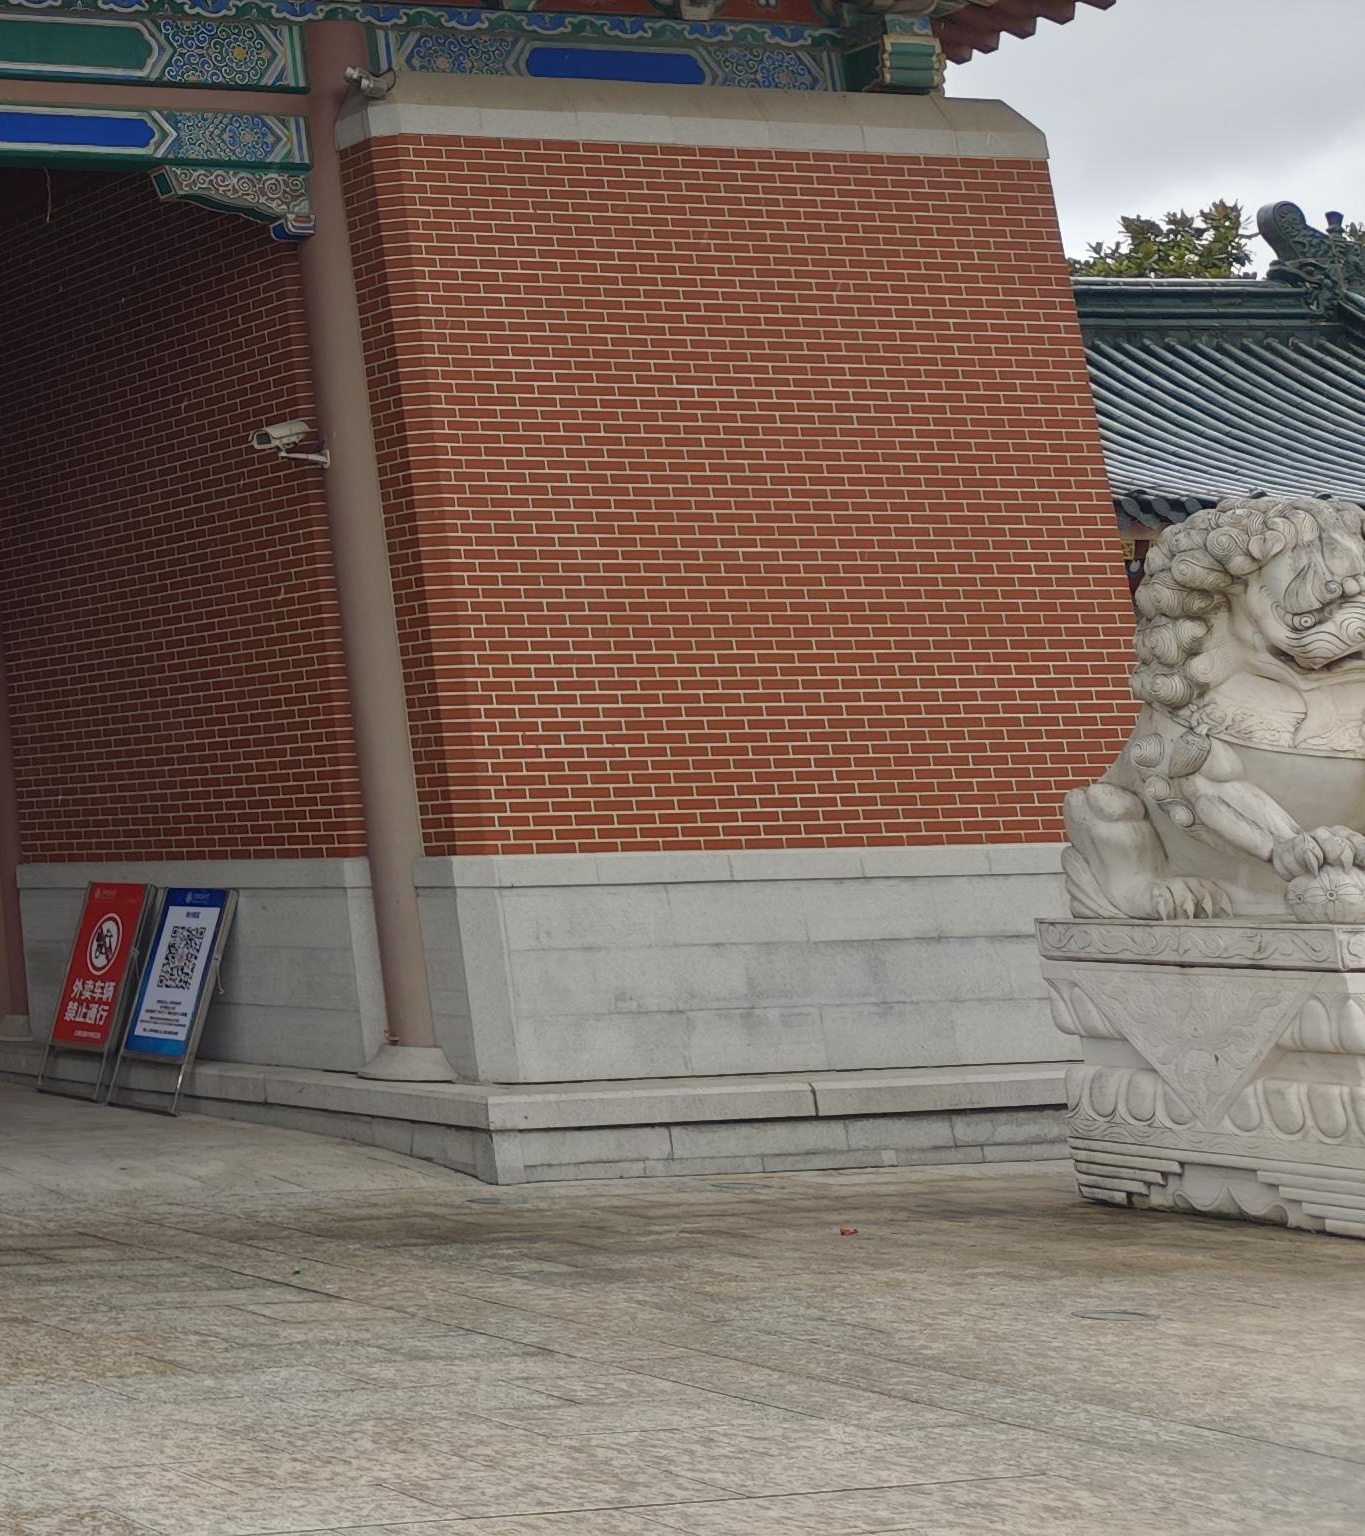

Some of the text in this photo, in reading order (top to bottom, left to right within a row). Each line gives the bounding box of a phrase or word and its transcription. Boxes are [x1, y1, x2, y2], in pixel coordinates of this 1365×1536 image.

[70, 978, 116, 1002] 外卖车辆
[64, 1001, 110, 1025] 禁止通行
